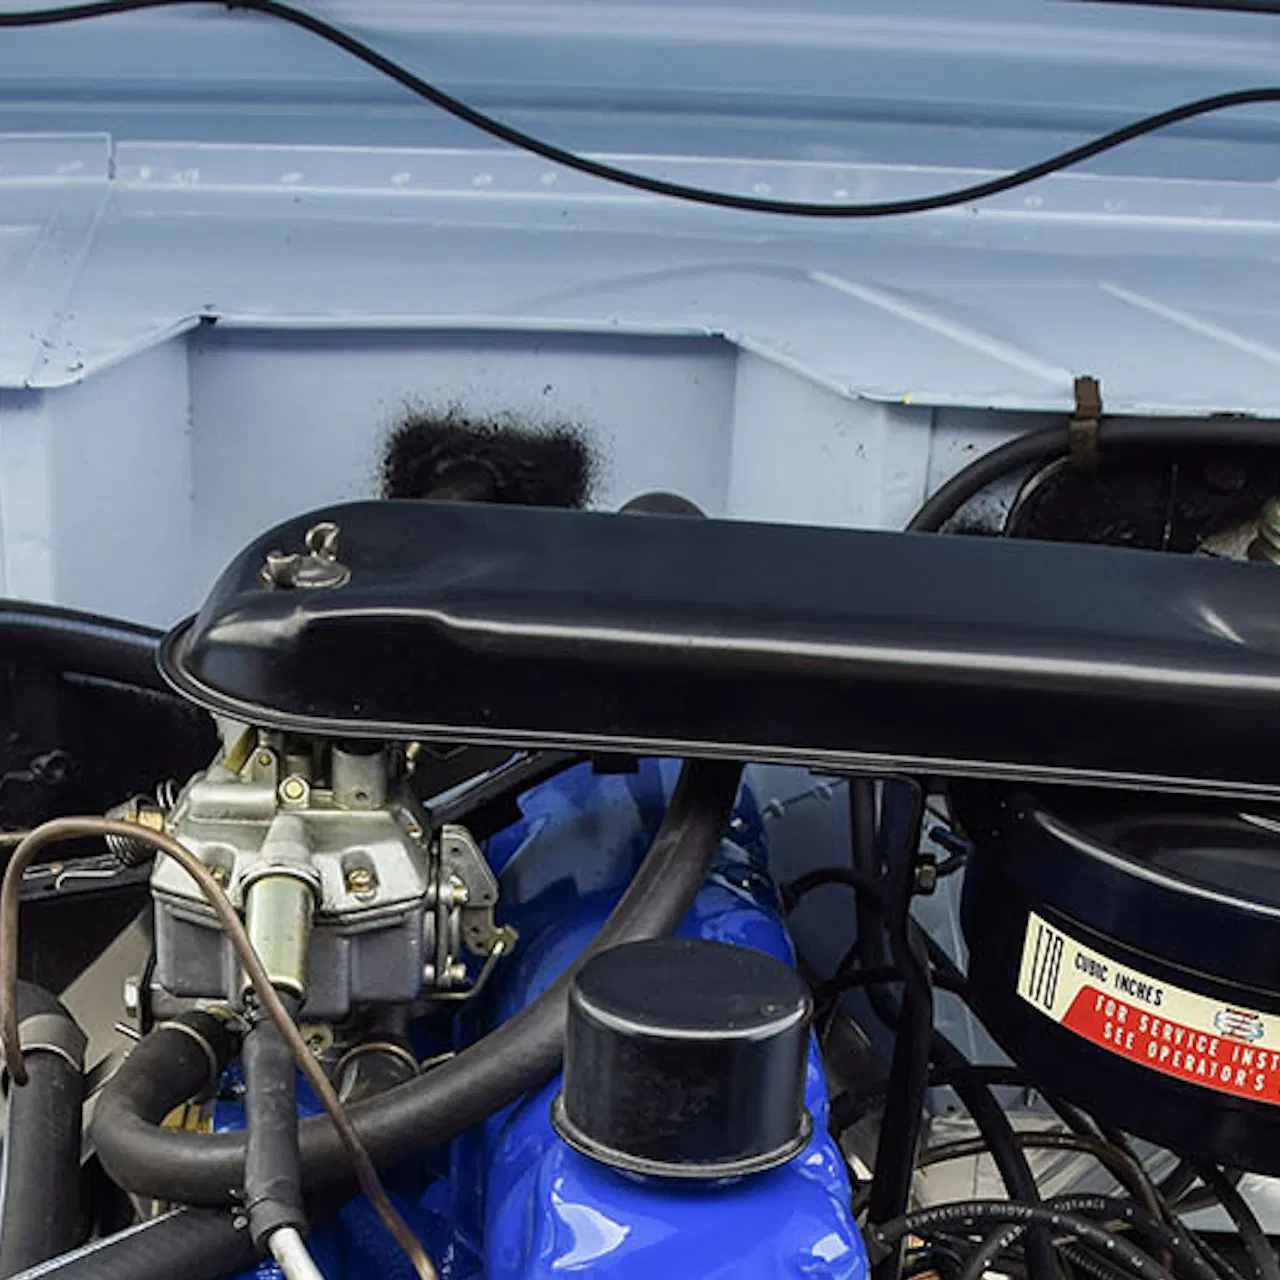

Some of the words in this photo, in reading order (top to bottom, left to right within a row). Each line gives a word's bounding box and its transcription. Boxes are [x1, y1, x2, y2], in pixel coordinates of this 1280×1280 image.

[1029, 925, 1064, 1010] 170
[1075, 952, 1108, 982] CUBIC
[1115, 973, 1163, 1006] INCHES
[1094, 995, 1128, 1023] FOR
[1139, 1014, 1220, 1057] SERVICE
[1104, 1021, 1135, 1049] SEE
[1148, 1041, 1265, 1091] OPERATOR'S
